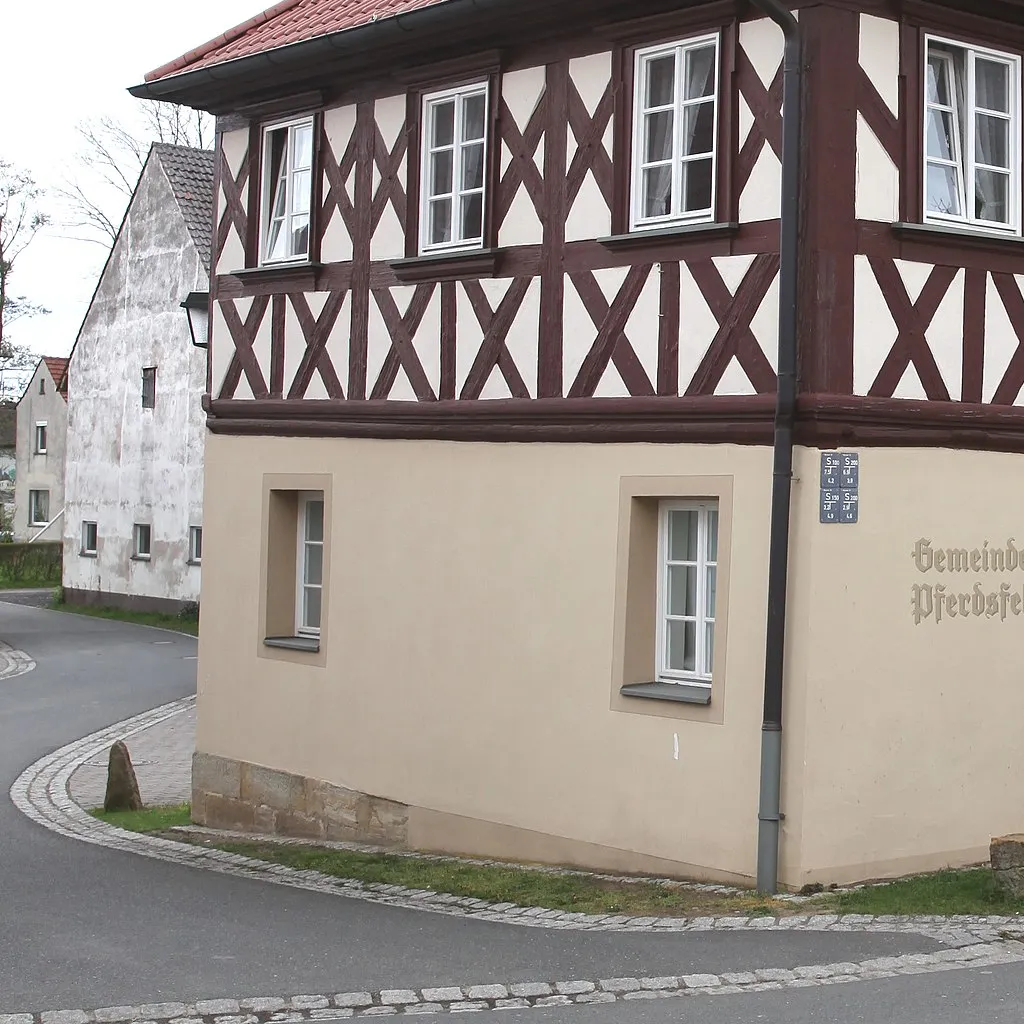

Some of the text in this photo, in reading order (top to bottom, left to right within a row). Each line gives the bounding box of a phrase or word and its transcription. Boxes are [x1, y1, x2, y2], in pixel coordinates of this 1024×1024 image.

[826, 457, 832, 465] S
[845, 457, 850, 465] S
[825, 492, 831, 500] S
[844, 492, 850, 500] S
